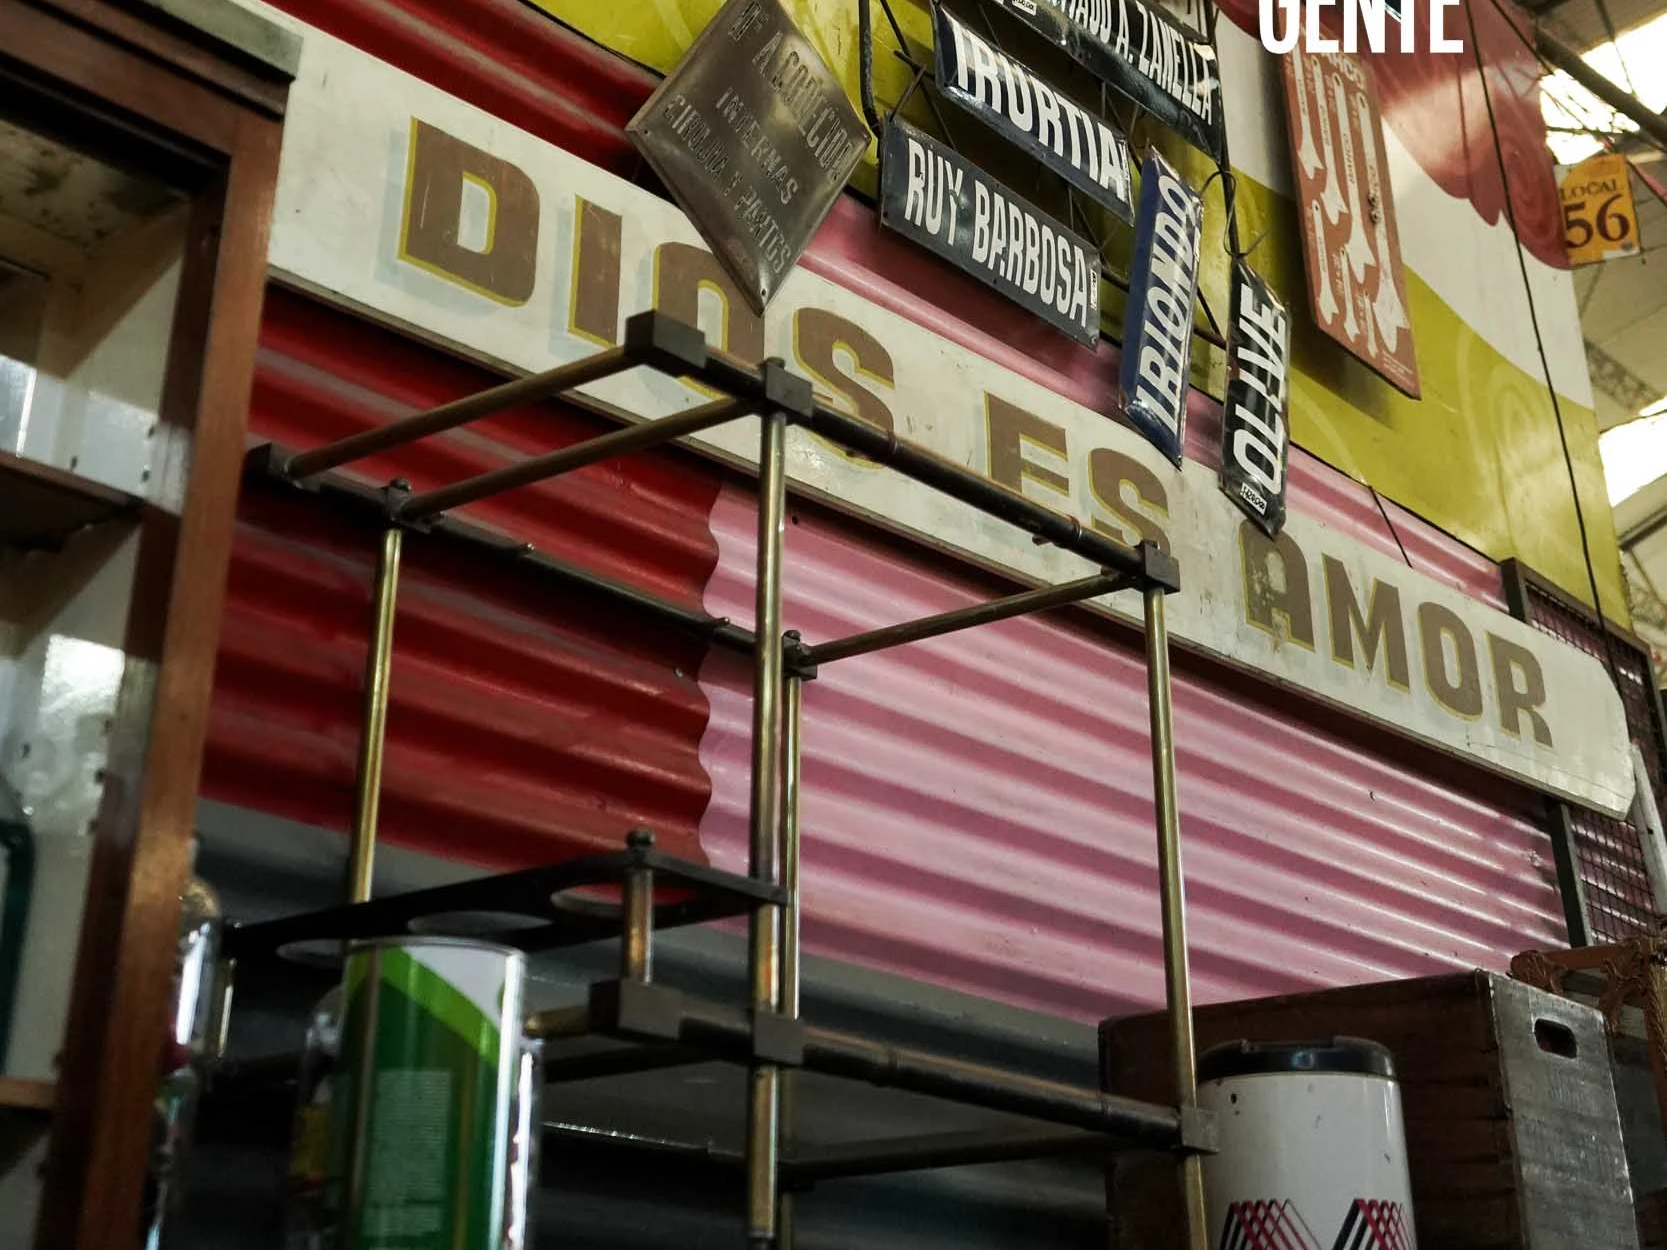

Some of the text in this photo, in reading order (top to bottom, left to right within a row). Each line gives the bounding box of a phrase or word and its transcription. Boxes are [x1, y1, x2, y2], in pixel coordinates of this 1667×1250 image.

[952, 20, 1129, 202] IRURTIA
[1136, 1, 1212, 126] ZANELLA
[904, 139, 1089, 328] RUY BARBOSA
[1559, 178, 1617, 200] LOCAL
[1564, 193, 1630, 249] 56
[1136, 174, 1191, 436] IRIONDO
[984, 391, 1170, 562] ES
[1238, 519, 1553, 747] AMOR
